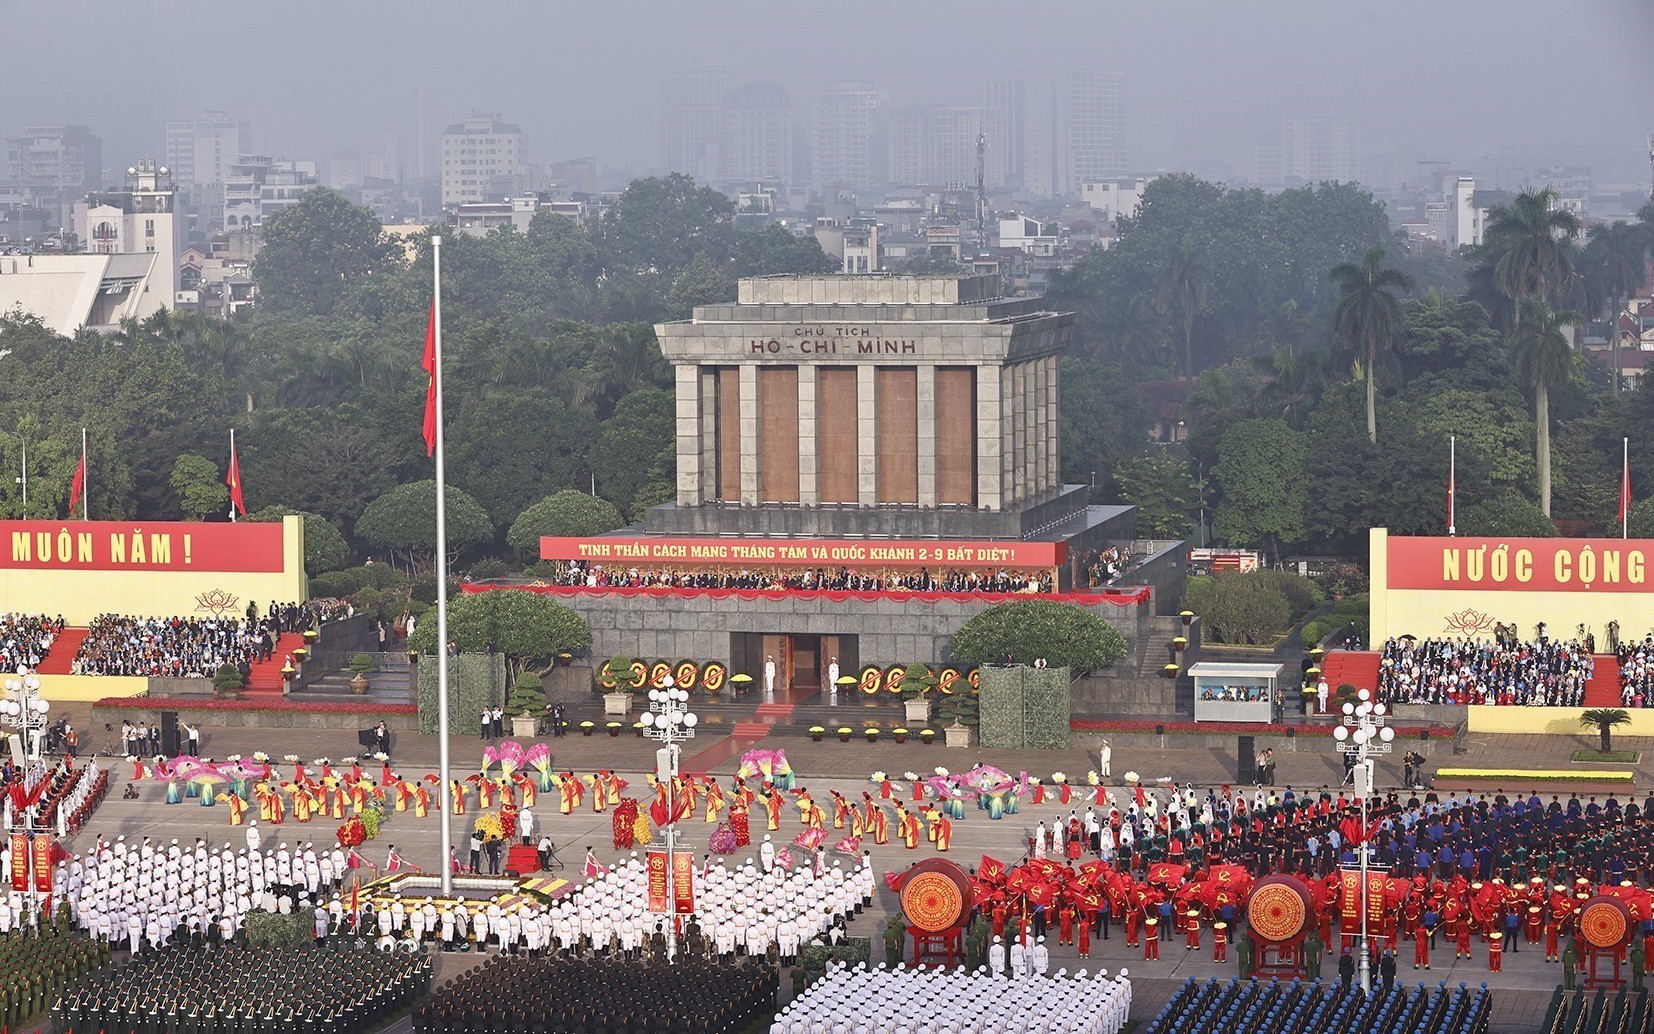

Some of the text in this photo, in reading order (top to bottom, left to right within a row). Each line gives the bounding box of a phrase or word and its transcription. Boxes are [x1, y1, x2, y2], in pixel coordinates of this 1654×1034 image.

[12, 527, 93, 563] MUÔN
[579, 544, 611, 556] TINH
[614, 541, 649, 557] THẦN
[653, 543, 687, 558] CÁCH
[691, 545, 728, 559] MẠNG
[731, 544, 776, 559] THÁNG
[779, 544, 807, 559] TÁM
[810, 545, 828, 560] VÀ
[831, 544, 866, 561] QUỐC
[870, 545, 915, 560] KHÁNH
[947, 545, 974, 561] BẤT
[1443, 544, 1645, 589] NƯỚC CỘNG
